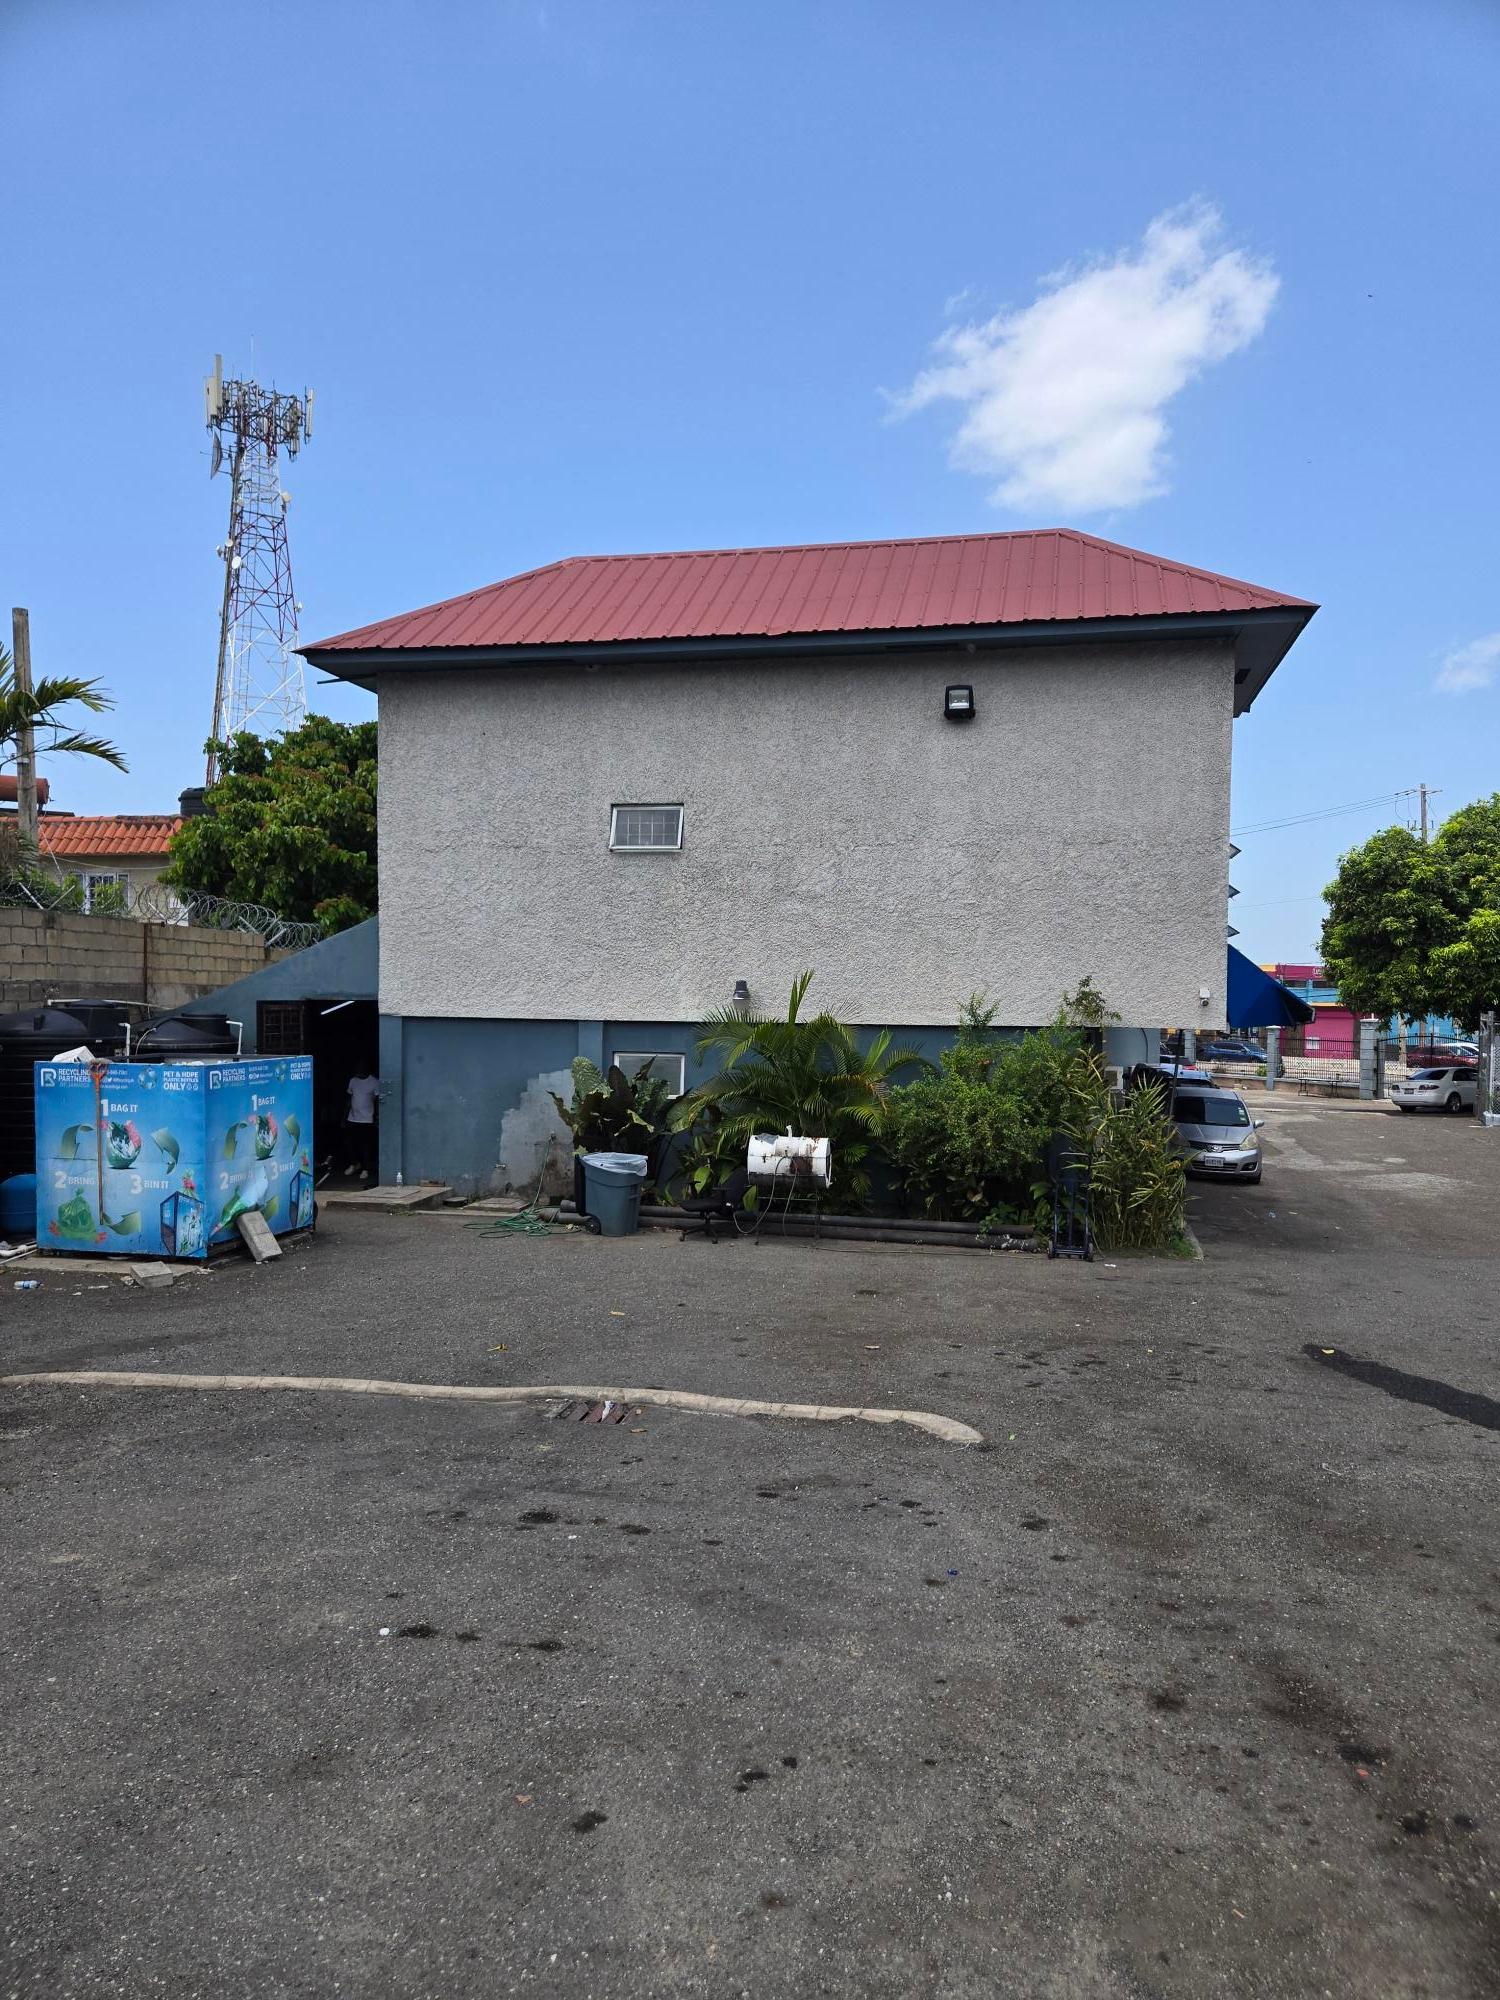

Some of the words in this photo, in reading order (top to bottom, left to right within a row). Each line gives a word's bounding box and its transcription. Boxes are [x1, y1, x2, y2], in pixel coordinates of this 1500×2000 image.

[58, 1068, 91, 1076] RECYCLING
[58, 1075, 92, 1083] PARTNERS
[222, 1067, 246, 1076] RECYCLING
[290, 1072, 305, 1080] ONLY
[163, 1083, 186, 1091] ONLY
[100, 1099, 109, 1117] 1
[110, 1103, 128, 1113] BAG
[129, 1104, 138, 1113] IT
[252, 1094, 258, 1112] 1
[258, 1097, 269, 1106] BAG
[269, 1096, 275, 1105] IT
[54, 1170, 67, 1189] 2
[68, 1176, 95, 1185] BRING
[271, 1161, 279, 1180] 3
[130, 1174, 143, 1194] 3
[144, 1180, 159, 1189] BIN
[219, 1171, 229, 1190] 2
